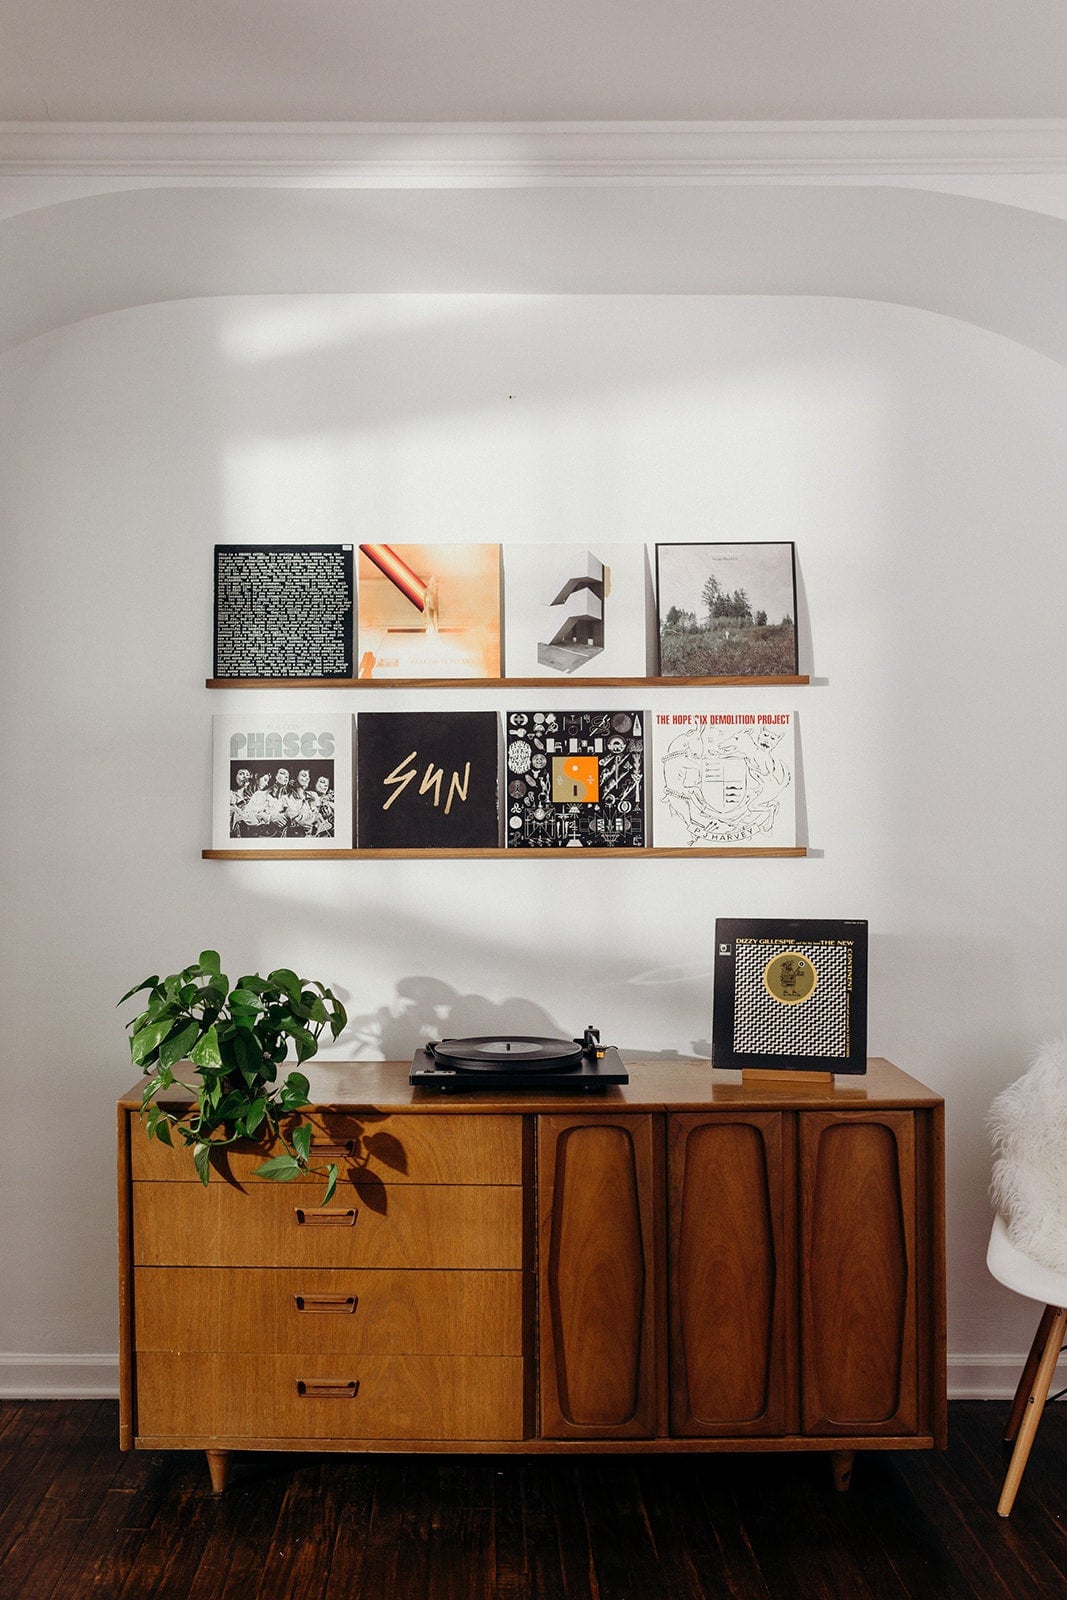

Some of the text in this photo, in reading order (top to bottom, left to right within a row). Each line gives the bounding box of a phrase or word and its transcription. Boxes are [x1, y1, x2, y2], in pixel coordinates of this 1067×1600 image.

[656, 715, 669, 725] THE
[673, 715, 691, 725] HOPE
[710, 715, 755, 725] DEMOLITION
[758, 715, 789, 725] PROJECT
[230, 732, 335, 757] PHASES
[383, 751, 470, 815] SUN
[711, 828, 753, 840] HARVEY
